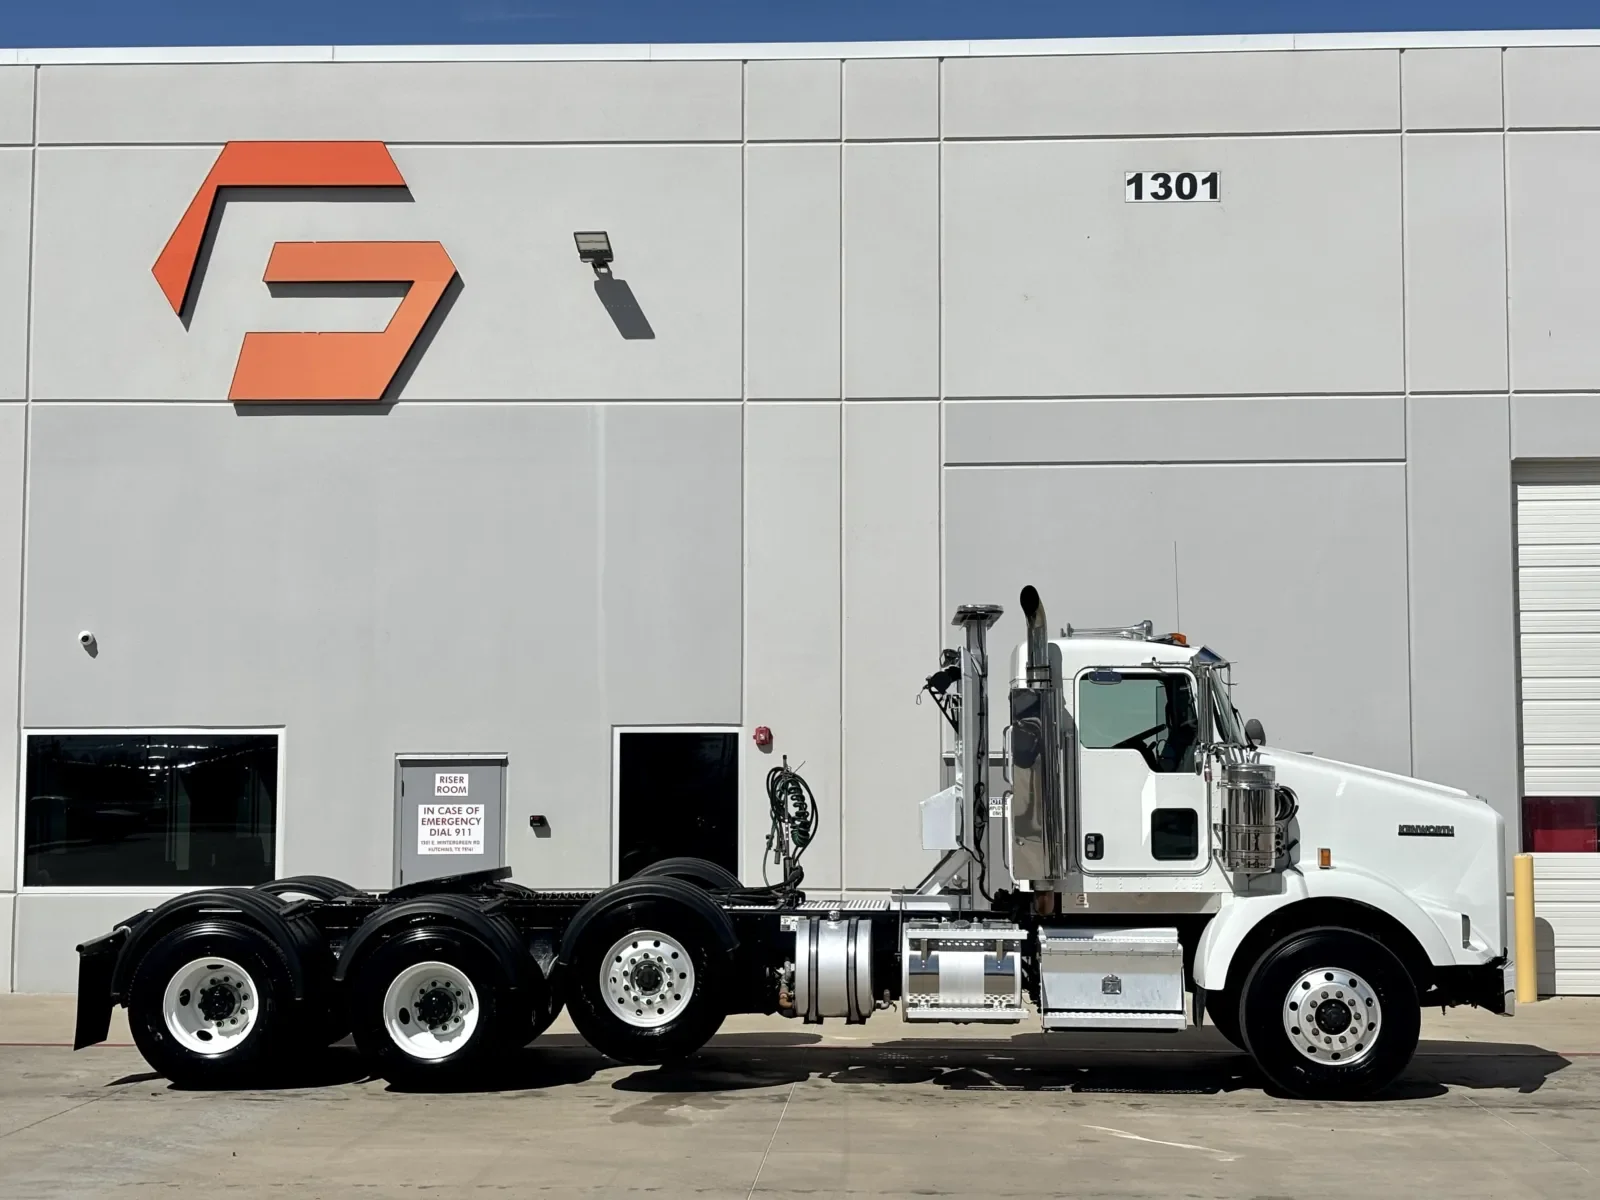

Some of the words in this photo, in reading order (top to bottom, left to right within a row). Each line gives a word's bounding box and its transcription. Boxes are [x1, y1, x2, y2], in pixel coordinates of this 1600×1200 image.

[1126, 172, 1218, 201] 1301
[439, 775, 465, 784] RISER
[436, 785, 467, 794] ROOM
[423, 806, 435, 815] IN
[437, 806, 463, 815] CASE
[465, 806, 480, 815] OF
[421, 817, 482, 826] EMERGENCY
[429, 828, 452, 837] DIAL
[454, 828, 472, 837] 911
